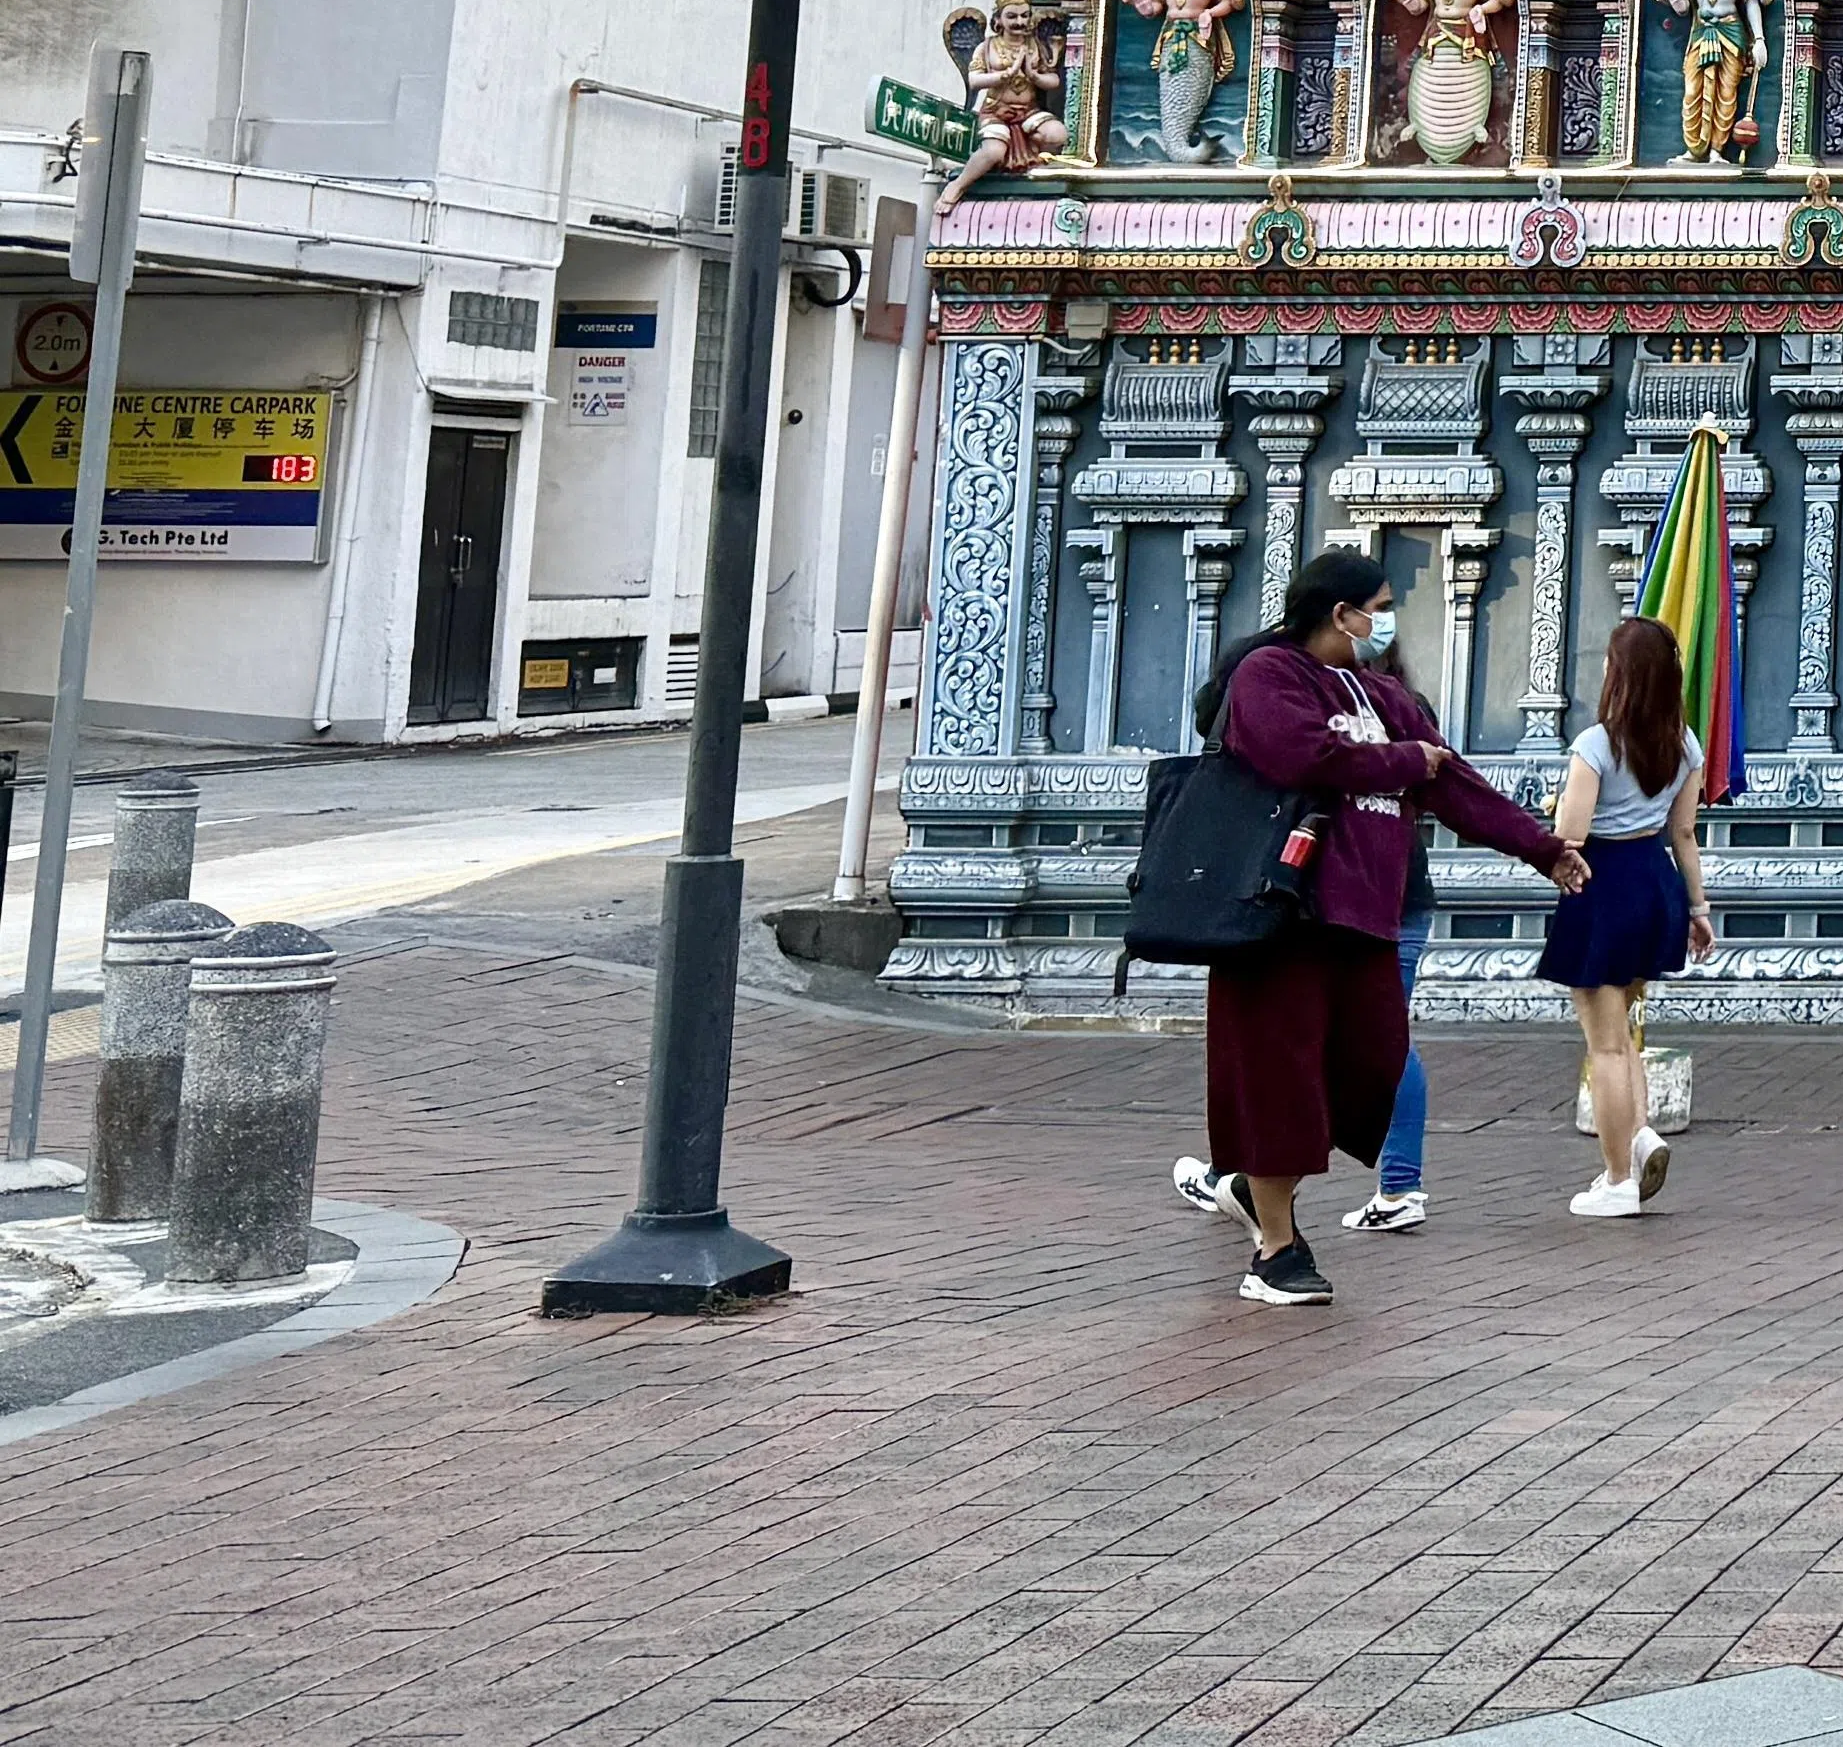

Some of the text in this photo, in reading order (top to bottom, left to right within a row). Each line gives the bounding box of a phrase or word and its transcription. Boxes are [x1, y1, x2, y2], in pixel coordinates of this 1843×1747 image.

[33, 334, 81, 351] 2.0m
[578, 356, 626, 368] DANGER
[151, 396, 223, 414] CENTRE
[230, 396, 317, 415] CARPARK
[54, 416, 316, 441] 金大厦停车场
[271, 456, 317, 482] 183
[120, 530, 159, 545] Tech
[166, 531, 195, 545] Pte
[200, 530, 228, 546] Ltd
